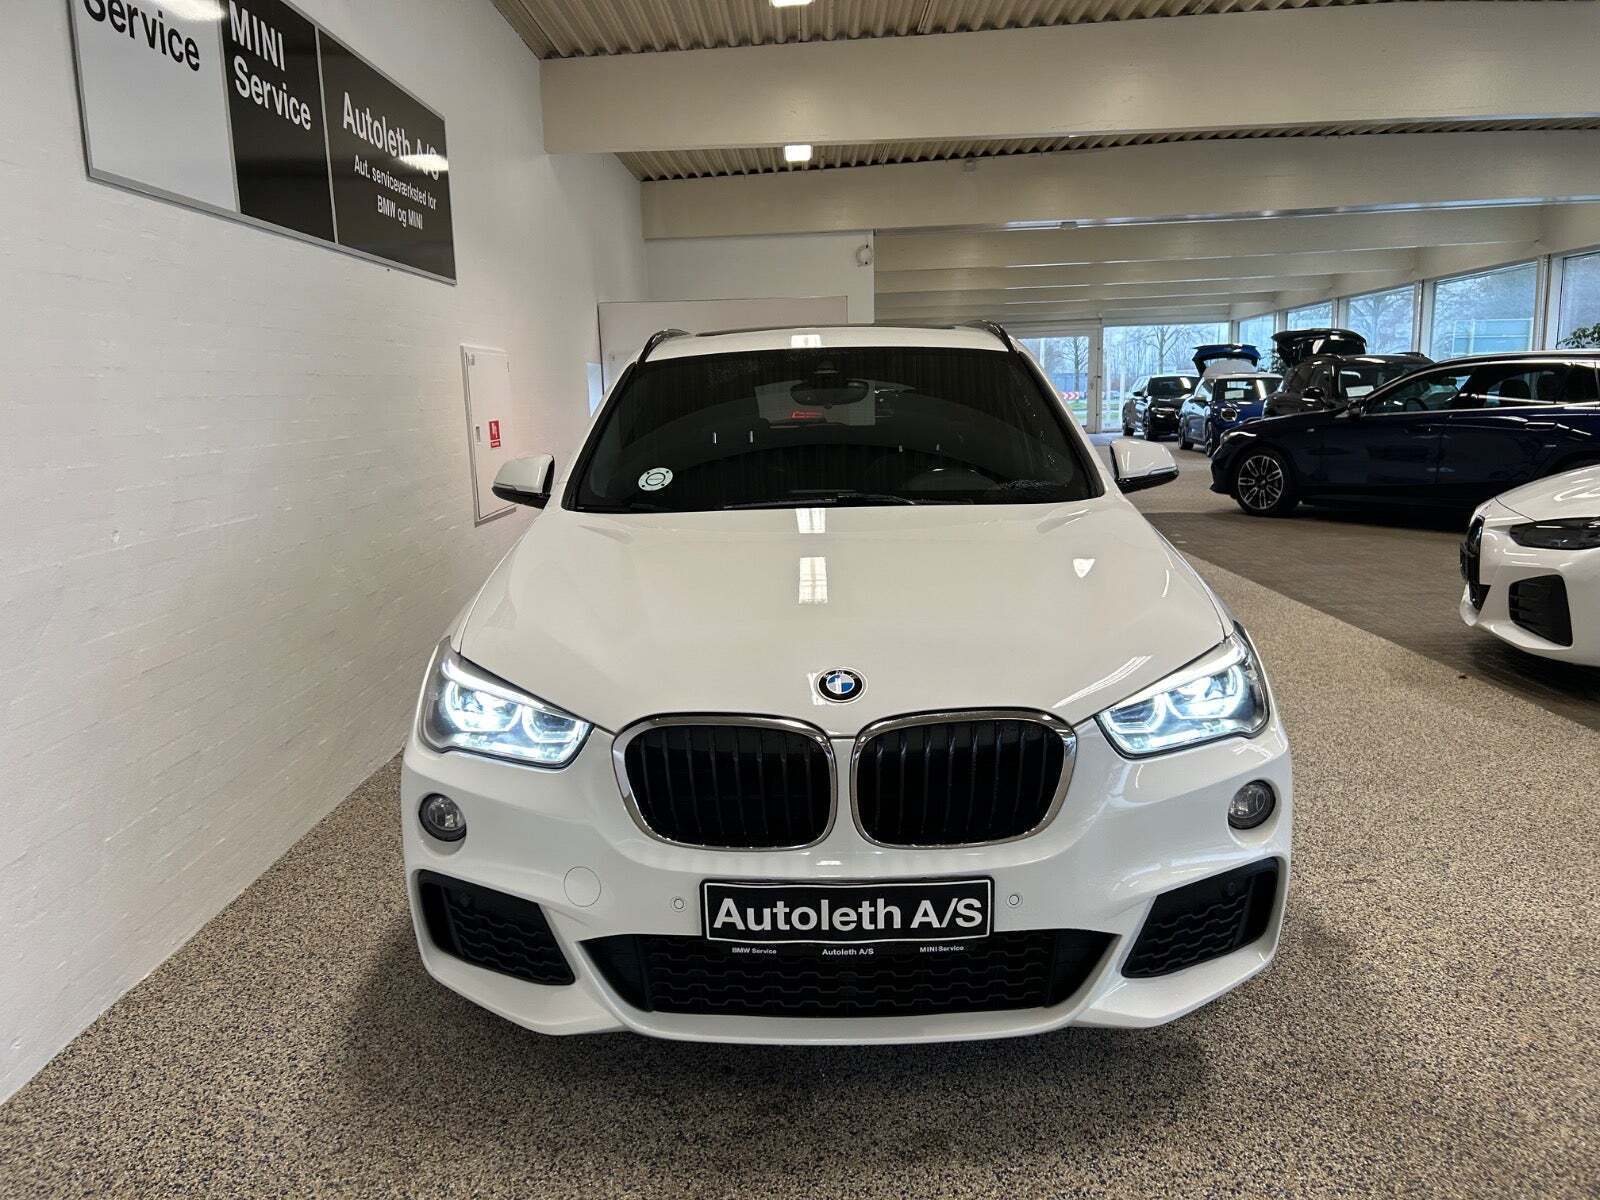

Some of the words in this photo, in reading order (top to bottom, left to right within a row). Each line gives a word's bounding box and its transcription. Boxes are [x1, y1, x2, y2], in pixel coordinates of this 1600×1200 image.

[229, 0, 285, 71] MINI
[233, 55, 311, 130] Service
[343, 91, 411, 165] Autoleth
[354, 154, 371, 178] Aut.
[377, 194, 396, 218] BMW
[397, 208, 407, 227] og
[408, 209, 423, 230] MINI
[713, 897, 901, 932] Autoleth
[909, 897, 983, 929] A/S
[751, 947, 777, 955] Service
[822, 948, 857, 956] Autoleth
[858, 948, 875, 956] A/S
